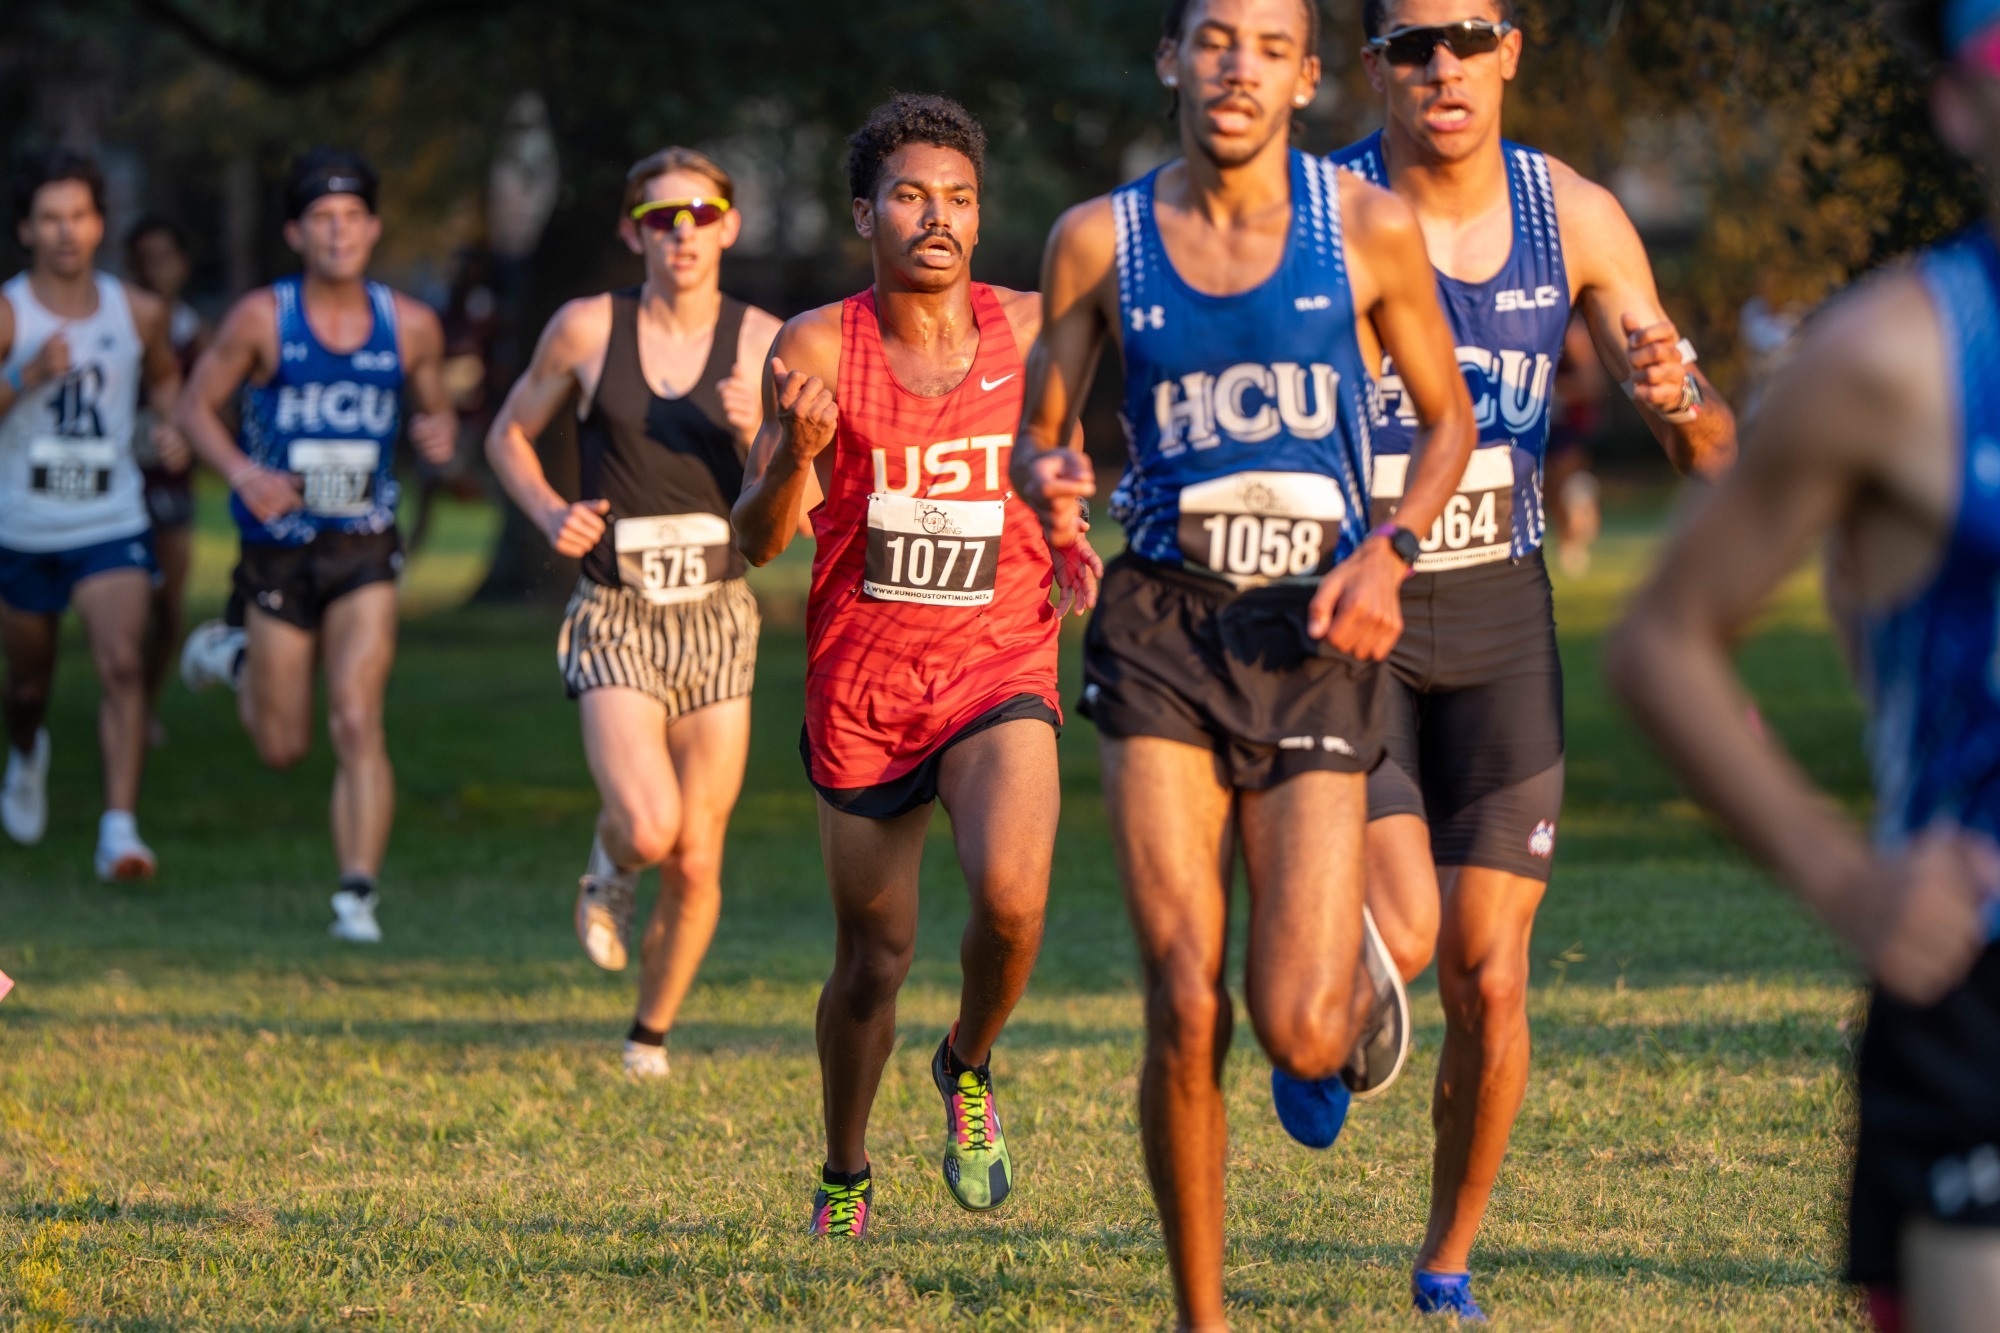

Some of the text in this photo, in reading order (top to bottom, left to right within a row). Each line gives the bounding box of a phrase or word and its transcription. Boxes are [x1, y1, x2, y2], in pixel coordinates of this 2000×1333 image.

[1495, 285, 1558, 312] SLC
[276, 380, 396, 437] HCU
[1153, 362, 1340, 457] HCU
[872, 433, 1013, 498] UST
[1203, 513, 1324, 577] 1058
[1417, 490, 1499, 552] 064
[641, 546, 708, 589] 575
[887, 536, 986, 589] 1077
[871, 585, 988, 601] WWW.RUNHOUSTONTIMING.NET
